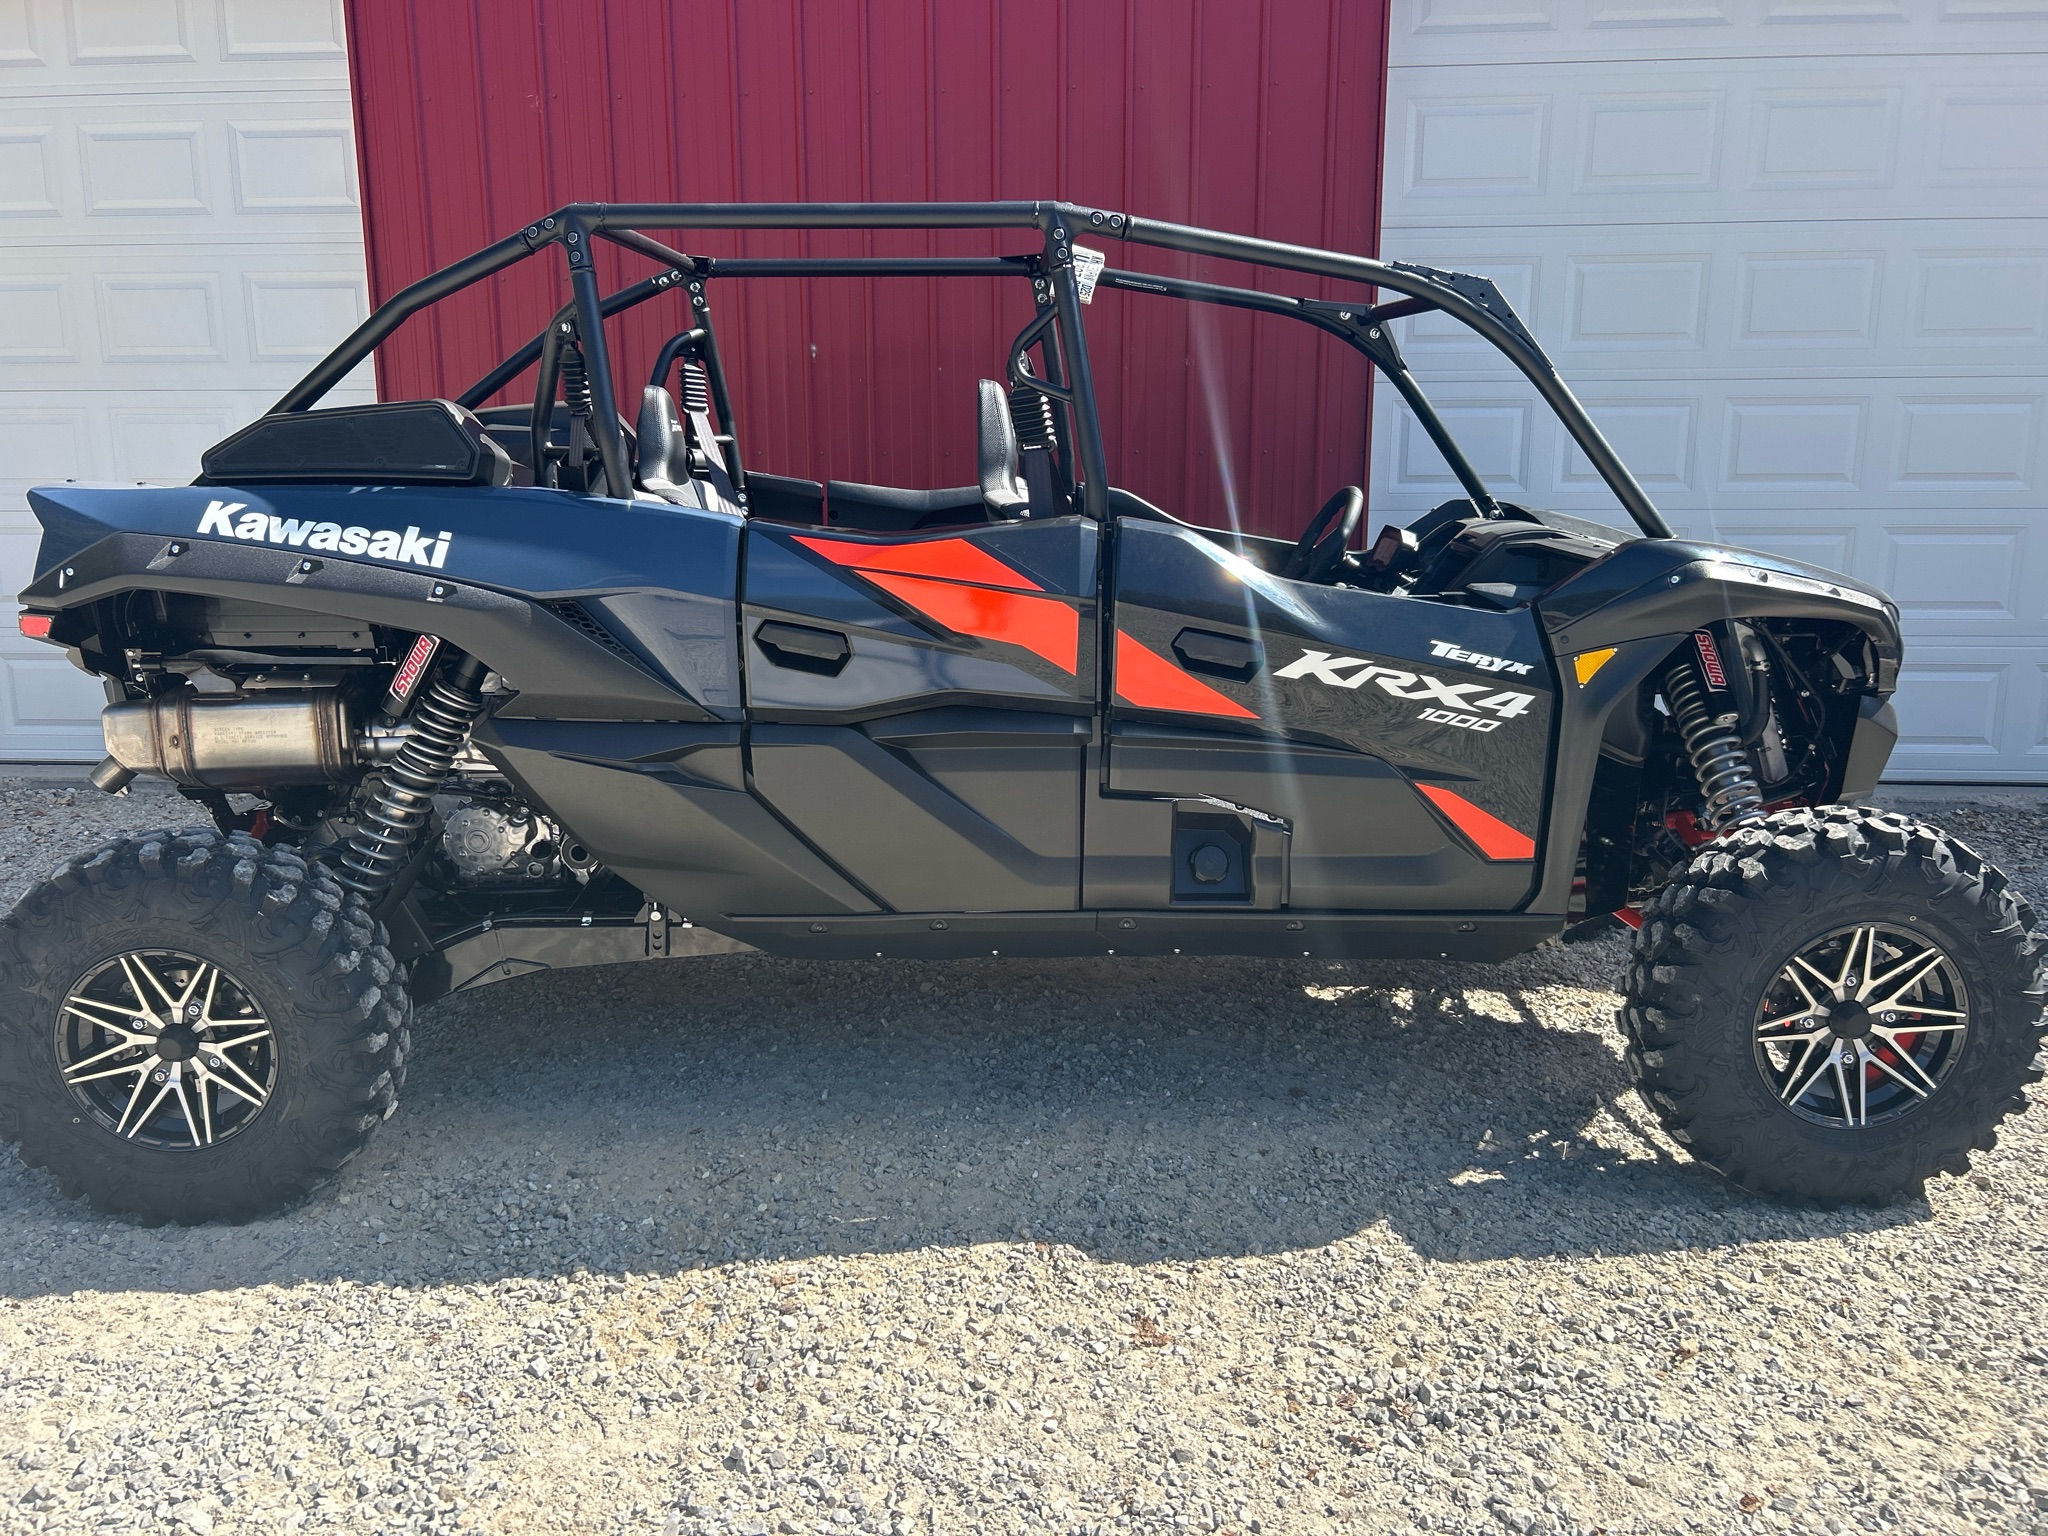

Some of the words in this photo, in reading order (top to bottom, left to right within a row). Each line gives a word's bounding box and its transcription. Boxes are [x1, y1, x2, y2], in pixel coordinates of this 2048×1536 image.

[197, 500, 452, 568] Kawasaki
[395, 635, 433, 697] SHOWA
[1272, 649, 1536, 718] KRX4
[1430, 640, 1534, 675] TERYX
[1695, 634, 1727, 685] SHOWA
[1416, 708, 1502, 732] 1000
